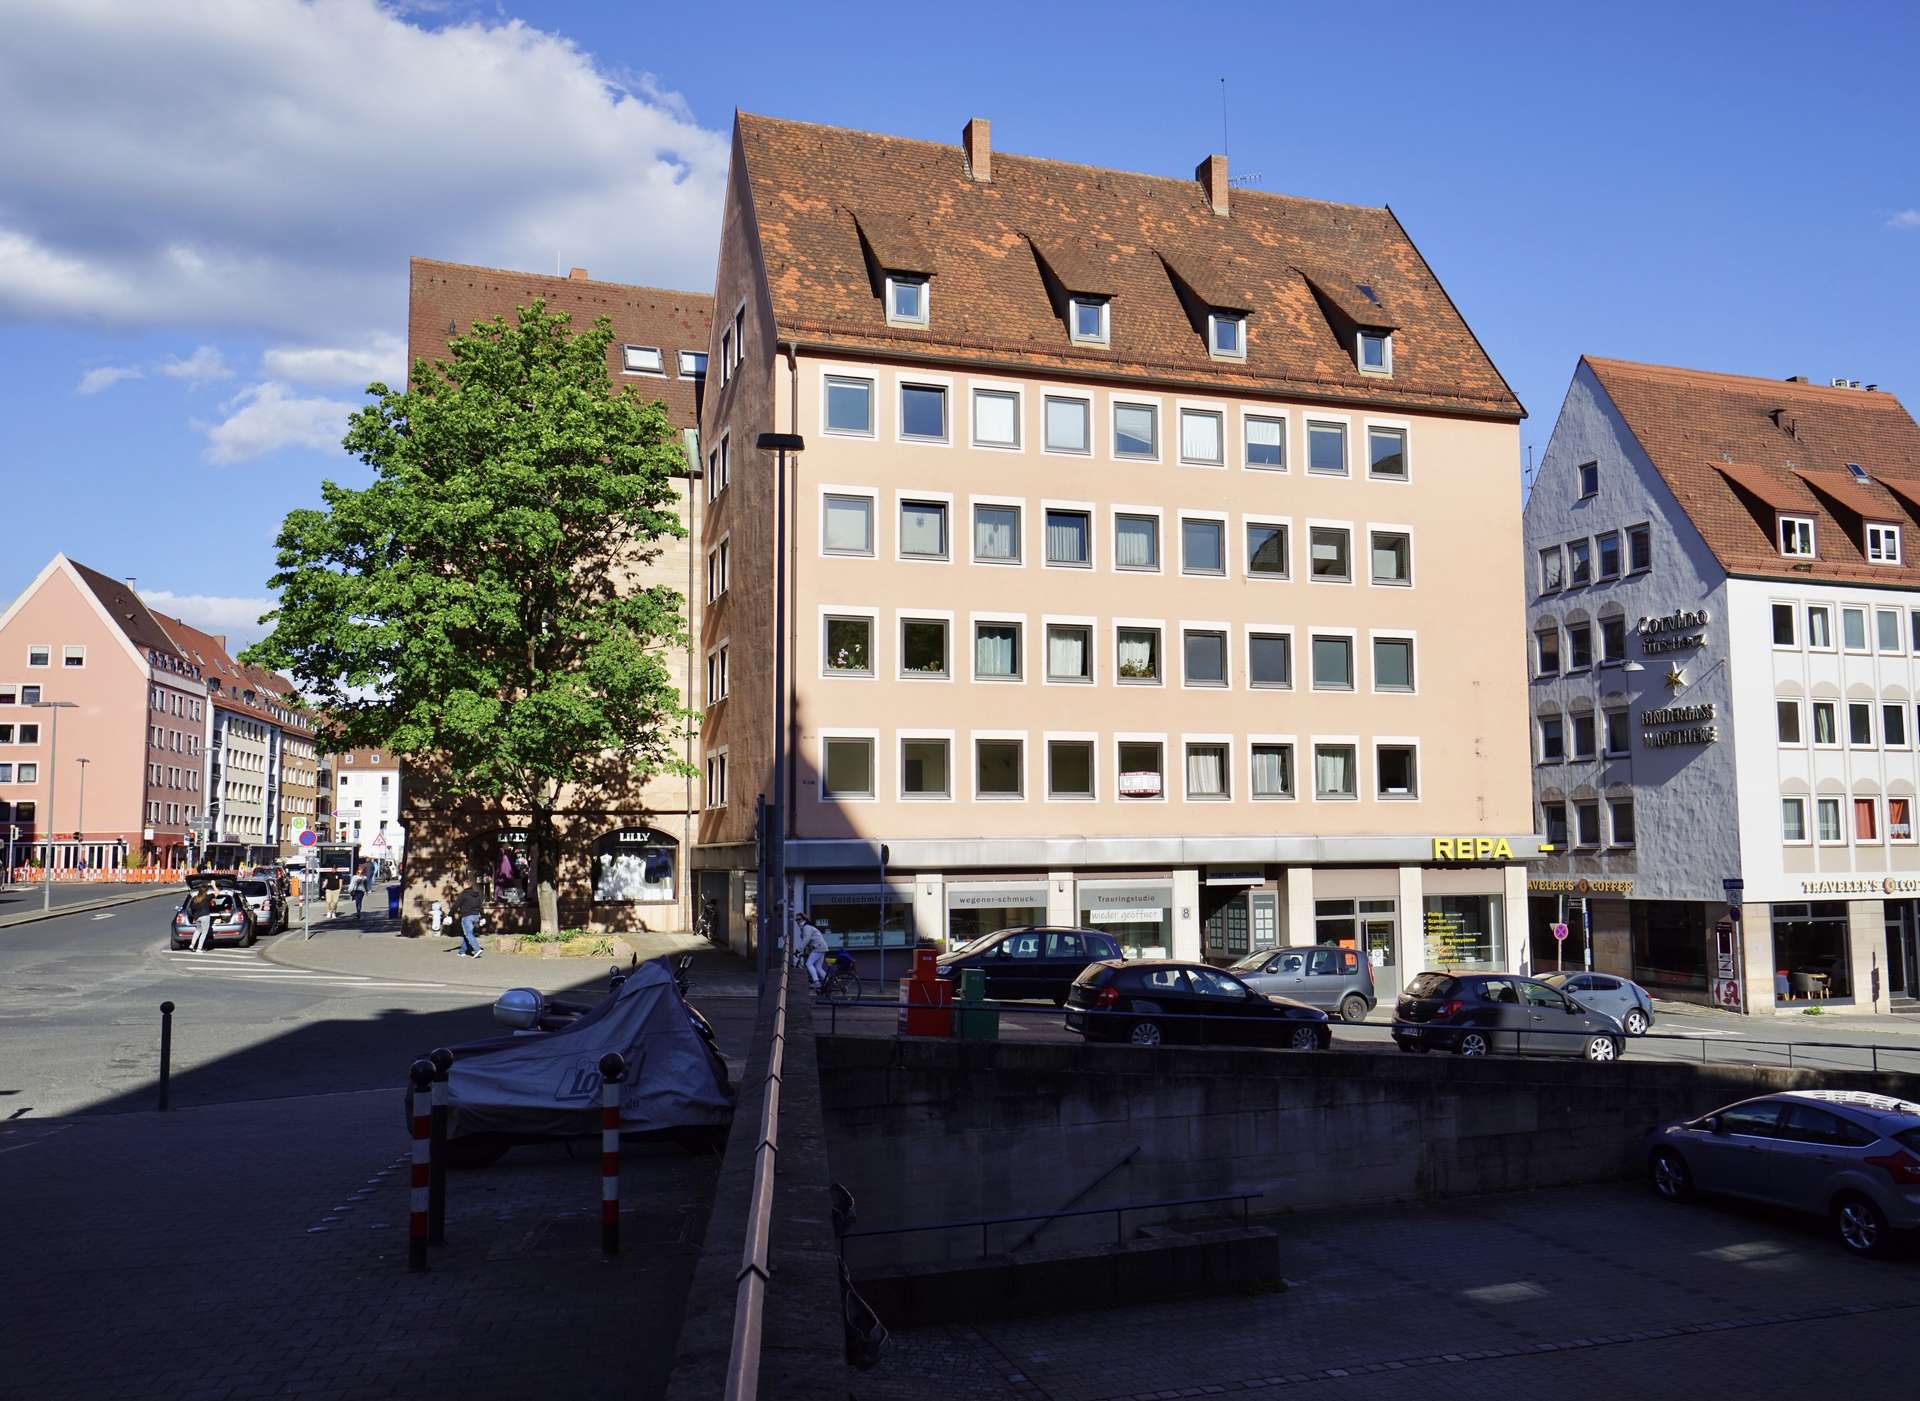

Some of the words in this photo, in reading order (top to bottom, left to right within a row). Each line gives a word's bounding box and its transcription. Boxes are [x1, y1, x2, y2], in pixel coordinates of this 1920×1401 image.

[1637, 609, 1708, 634] Corvino
[619, 832, 650, 842] LILLY
[1432, 838, 1514, 860] REPA
[1592, 880, 1633, 892] COFFEE
[1801, 879, 1880, 894] TRAVELER'S
[1097, 895, 1156, 904] Trauringstudio
[1182, 908, 1190, 919] 8
